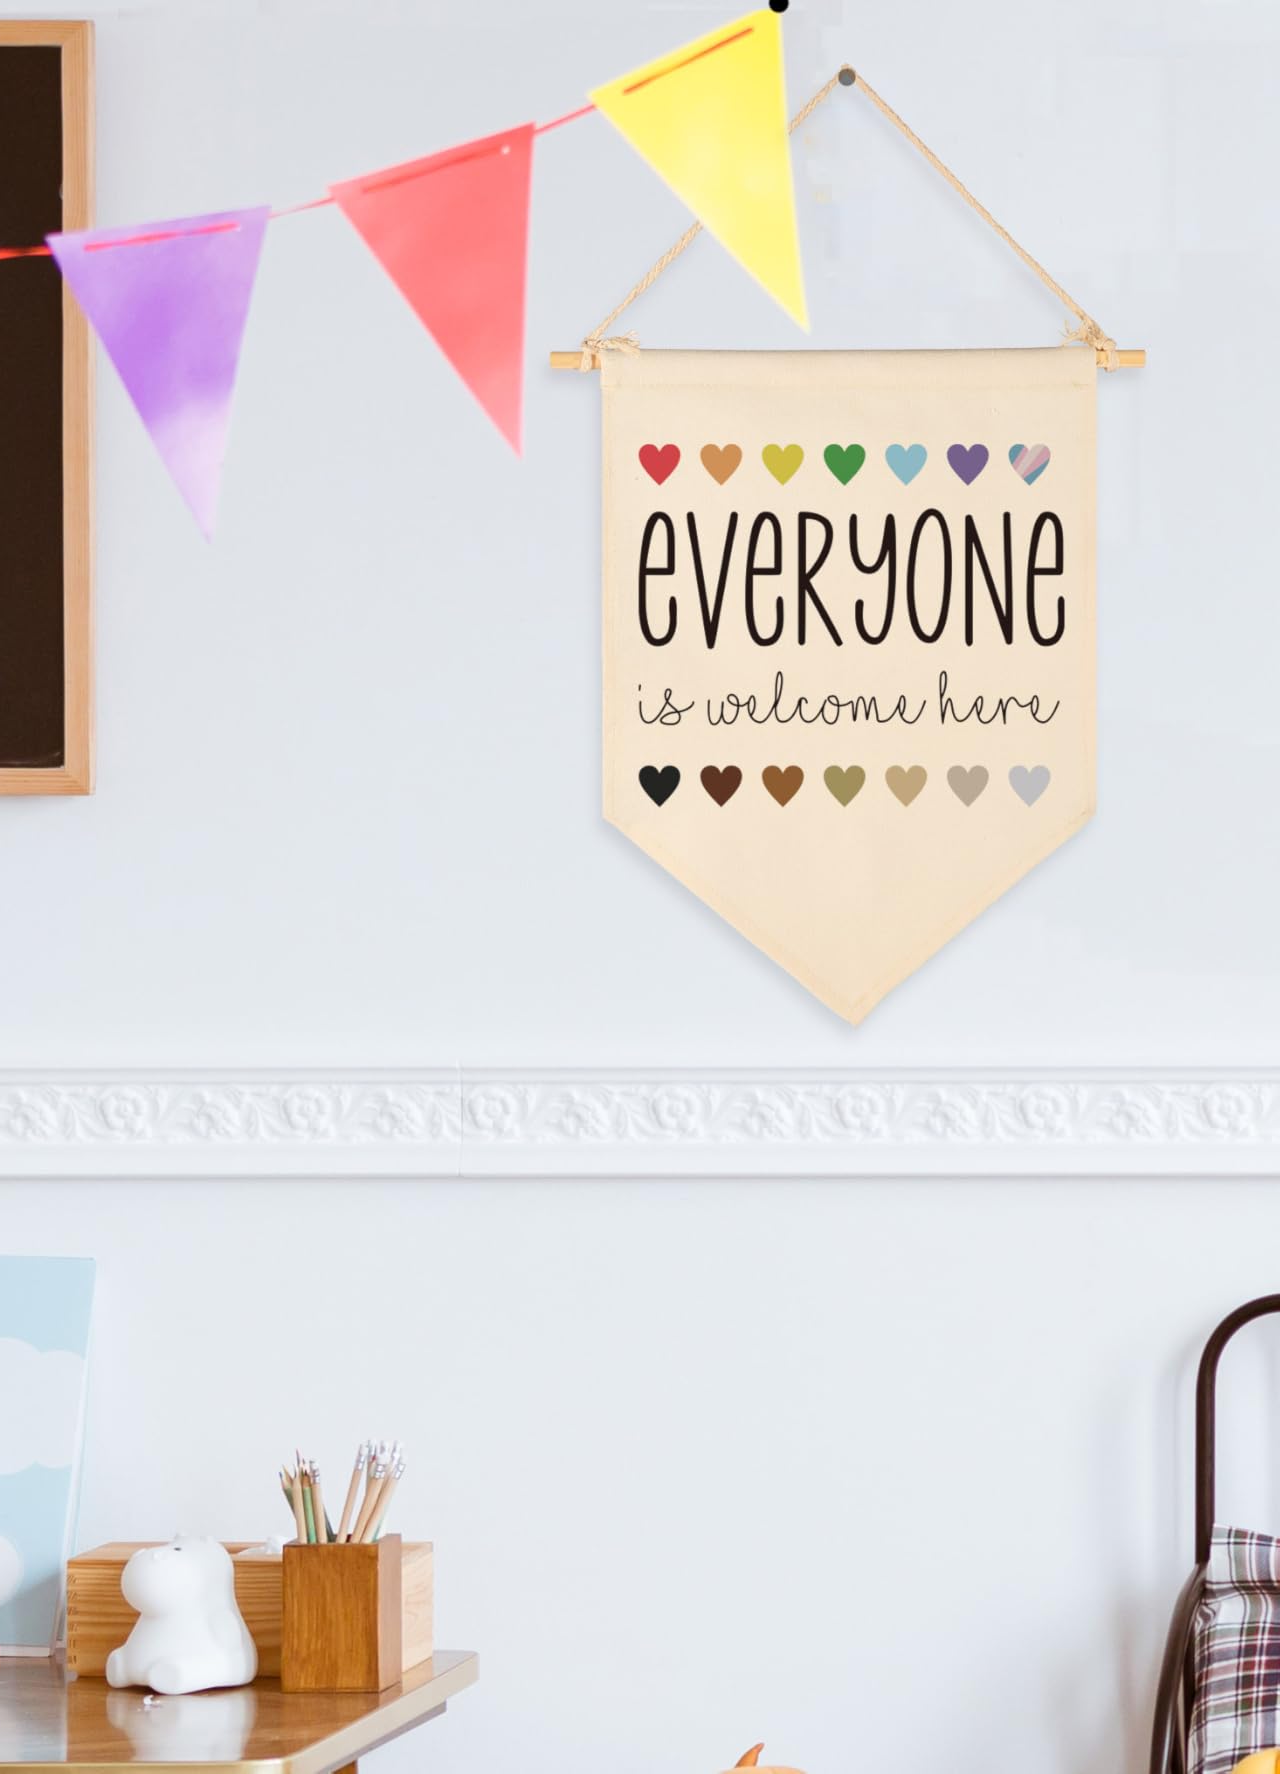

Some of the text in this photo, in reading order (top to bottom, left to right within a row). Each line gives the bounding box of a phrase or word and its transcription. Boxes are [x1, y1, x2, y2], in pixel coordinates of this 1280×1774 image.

[637, 670, 1060, 726] is welcome here
